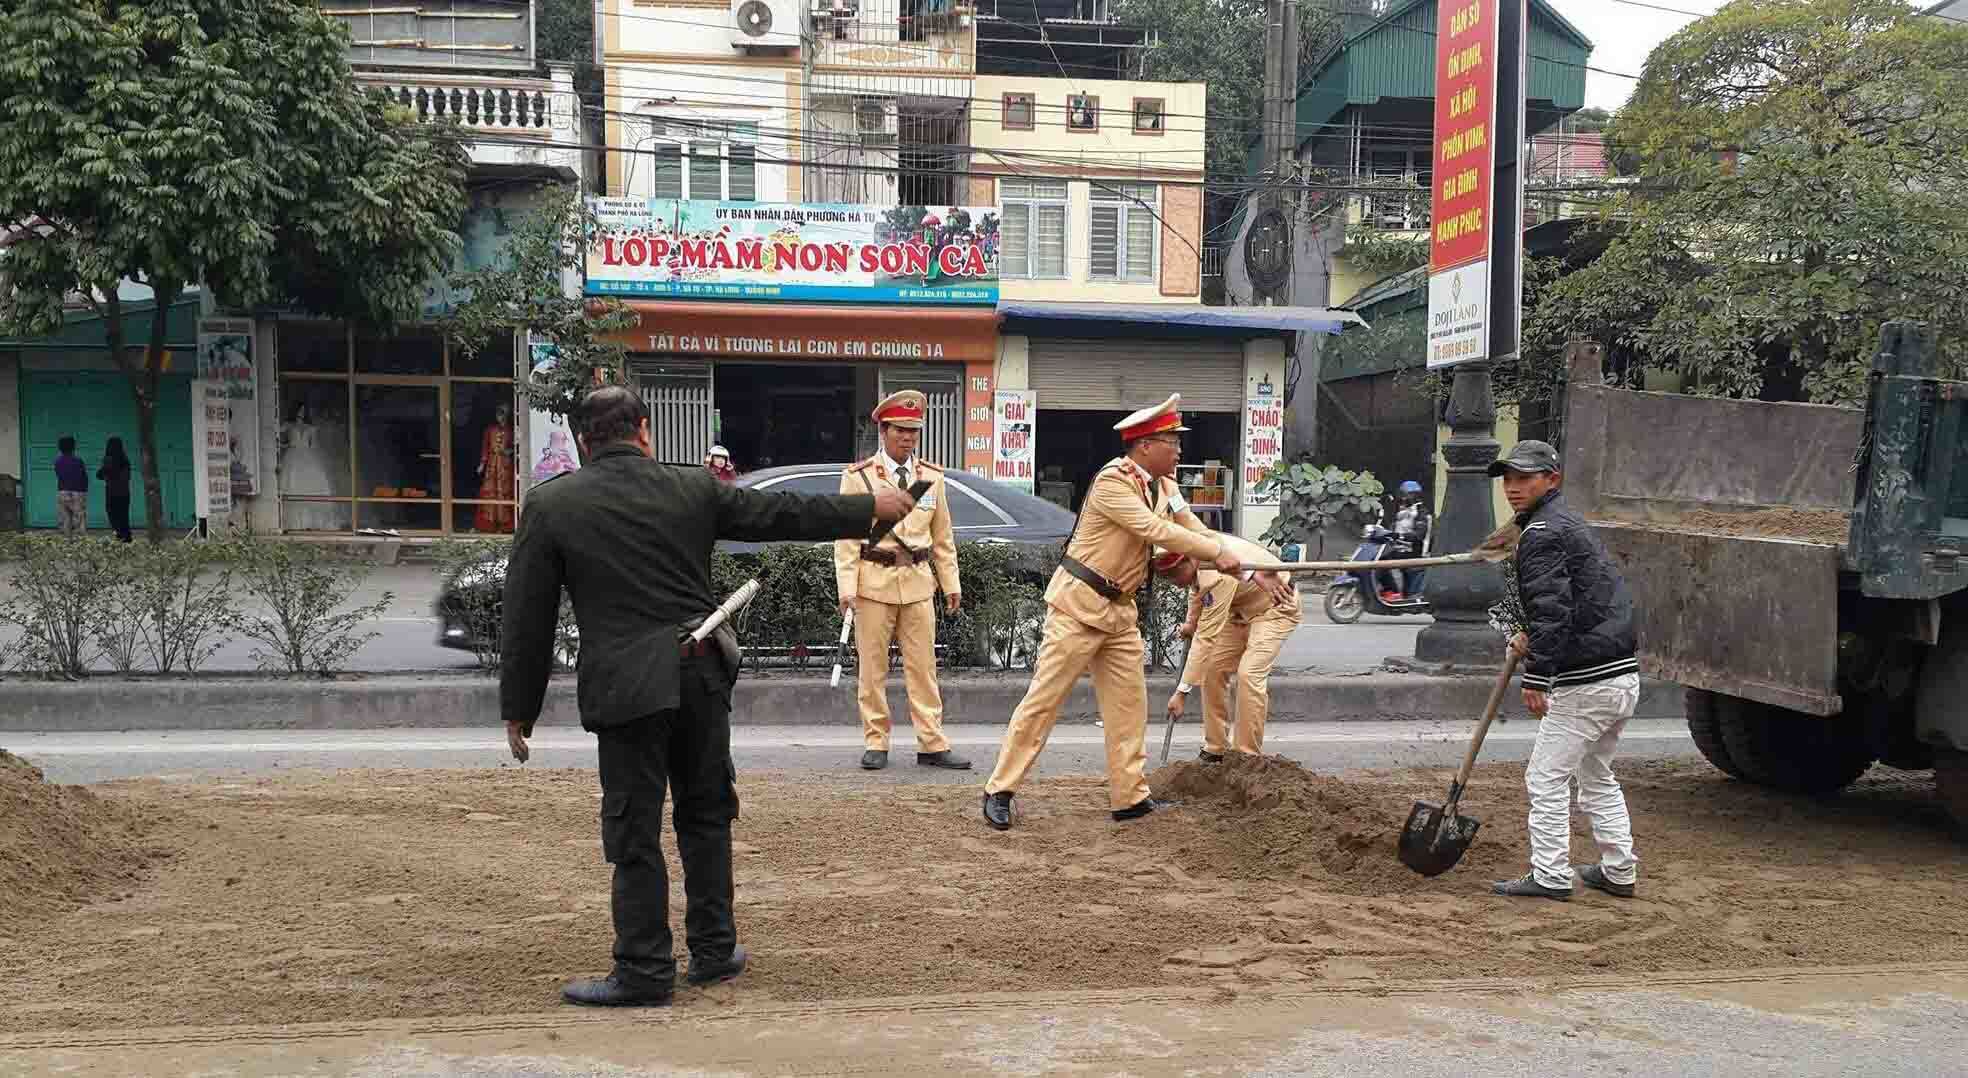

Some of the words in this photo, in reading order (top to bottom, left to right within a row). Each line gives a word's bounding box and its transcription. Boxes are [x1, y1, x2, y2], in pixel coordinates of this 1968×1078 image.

[1443, 177, 1457, 201] GIA
[731, 208, 751, 220] BAN
[754, 207, 781, 220] NHÂN
[679, 224, 764, 270] MẦM
[772, 241, 850, 273] NON
[859, 242, 930, 275] SƠN
[939, 244, 988, 276] CA
[1434, 309, 1453, 328] DOJI
[1454, 304, 1478, 321] LAND
[779, 338, 801, 354] LAI
[807, 340, 838, 355] CON
[844, 341, 866, 356] EM
